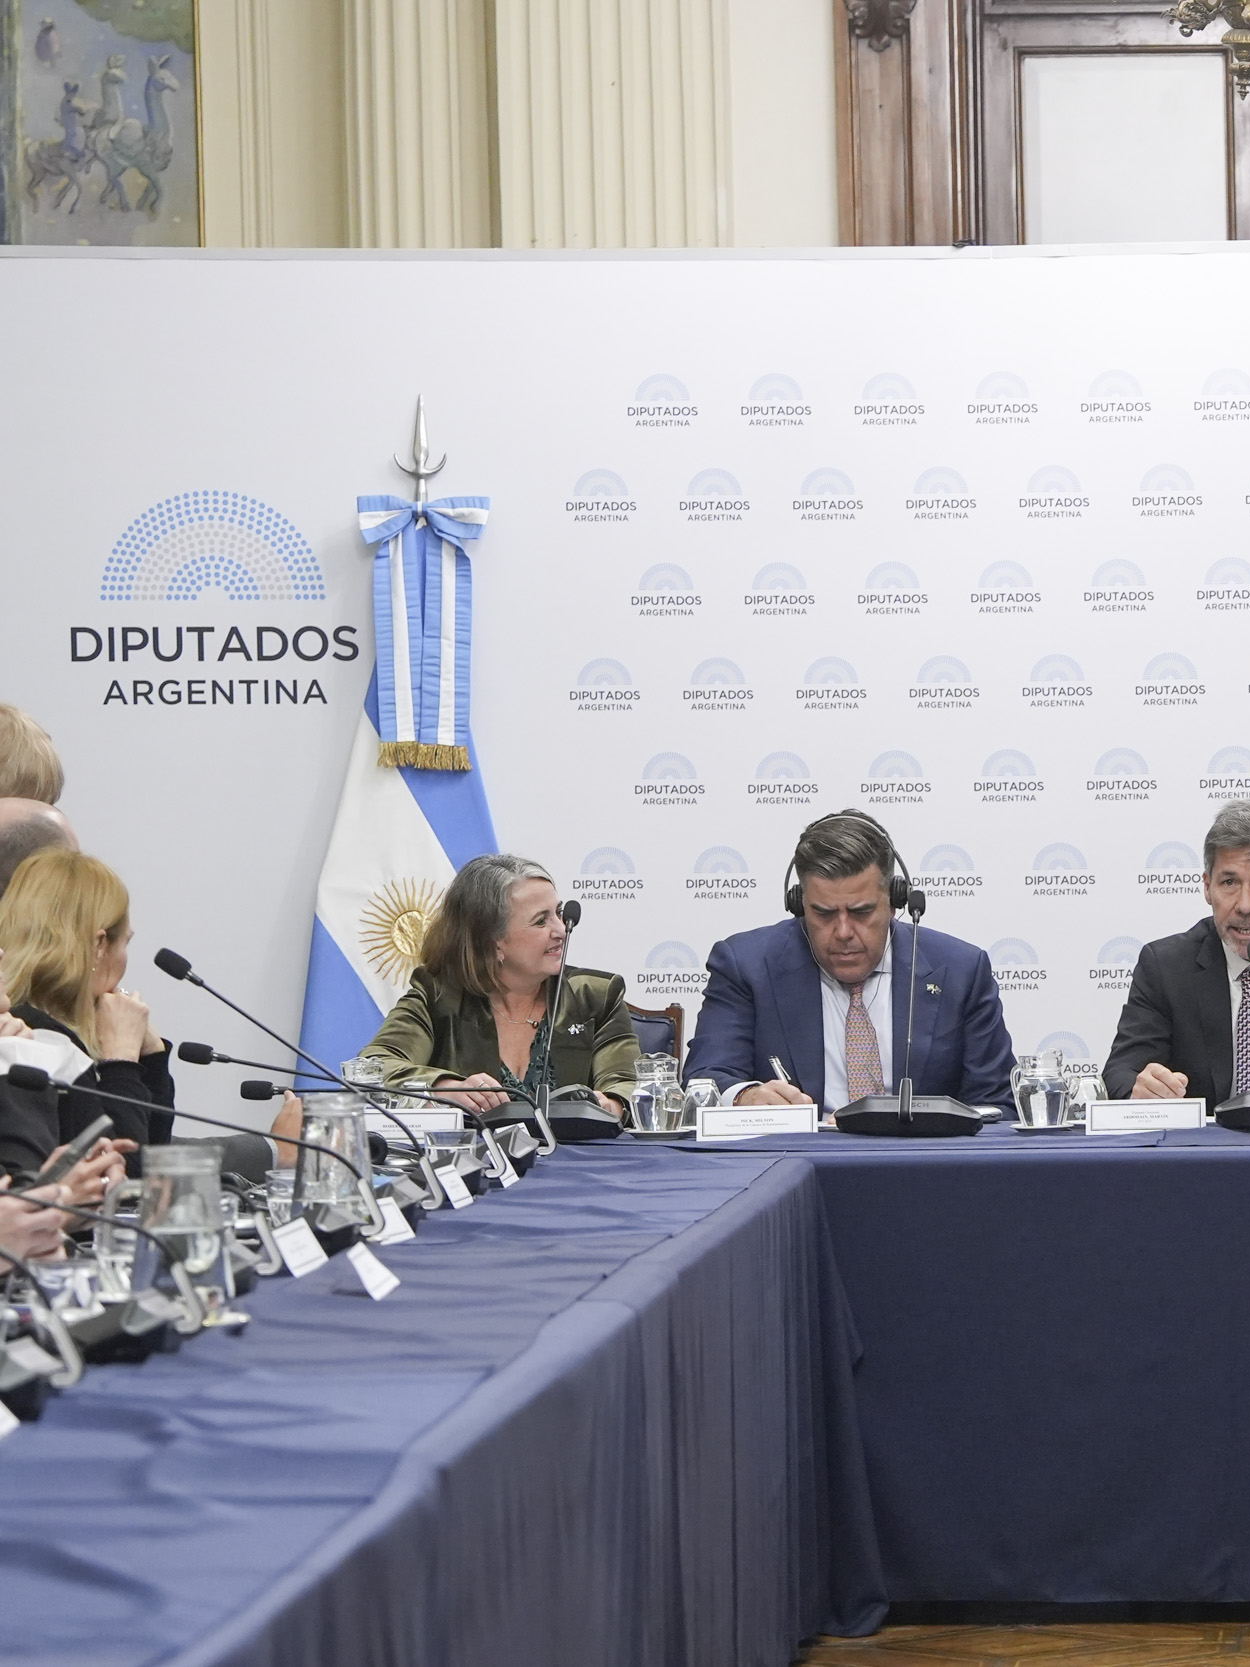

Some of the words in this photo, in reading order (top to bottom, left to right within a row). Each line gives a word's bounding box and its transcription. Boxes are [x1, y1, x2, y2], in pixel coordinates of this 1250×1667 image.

[627, 406, 699, 417] DIPUTADOS
[740, 405, 812, 416] DIPUTADOS
[854, 404, 925, 416] DIPUTADOS
[967, 403, 1039, 414] DIPUTADOS
[635, 419, 691, 427] ARGENTINA
[748, 418, 804, 427] ARGENTINA
[862, 417, 918, 426] ARGENTINA
[975, 416, 1031, 425] ARGENTINA
[565, 501, 637, 512] DIPUTADOS
[679, 500, 751, 511] DIPUTADOS
[792, 499, 864, 511] DIPUTADOS
[905, 498, 977, 510] DIPUTADOS
[1018, 497, 1090, 508] DIPUTADOS
[1132, 495, 1203, 507] DIPUTADOS
[573, 514, 629, 522] ARGENTINA
[687, 513, 743, 522] ARGENTINA
[800, 513, 856, 521] ARGENTINA
[913, 512, 969, 520] ARGENTINA
[1026, 510, 1082, 519] ARGENTINA
[1140, 508, 1195, 517] ARGENTINA
[630, 595, 703, 606] DIPUTADOS
[744, 594, 816, 606] DIPUTADOS
[857, 593, 929, 605] DIPUTADOS
[970, 592, 1042, 604] DIPUTADOS
[1083, 590, 1155, 602] DIPUTADOS
[638, 608, 695, 617] ARGENTINA
[752, 607, 808, 616] ARGENTINA
[865, 606, 921, 615] ARGENTINA
[978, 605, 1034, 614] ARGENTINA
[1091, 604, 1147, 612] ARGENTINA
[70, 625, 359, 663] DIPUTADOS
[103, 678, 327, 705] ARGENTINA
[569, 690, 641, 701] DIPUTADOS
[682, 689, 754, 700] DIPUTADOS
[795, 688, 867, 700] DIPUTADOS
[909, 687, 980, 699] DIPUTADOS
[1021, 686, 1093, 697] DIPUTADOS
[1134, 684, 1206, 696] DIPUTADOS
[690, 702, 746, 711] ARGENTINA
[804, 701, 860, 710] ARGENTINA
[917, 700, 973, 709] ARGENTINA
[1029, 699, 1085, 708] ARGENTINA
[1142, 697, 1198, 706] ARGENTINA
[577, 703, 633, 712] ARGENTINA
[634, 784, 706, 795] DIPUTADOS
[747, 783, 819, 795] DIPUTADOS
[860, 782, 932, 794] DIPUTADOS
[973, 781, 1045, 792] DIPUTADOS
[1086, 779, 1158, 791] DIPUTADOS
[642, 797, 698, 806] ARGENTINA
[755, 796, 811, 805] ARGENTINA
[868, 795, 924, 804] ARGENTINA
[981, 794, 1037, 803] ARGENTINA
[1094, 792, 1150, 801] ARGENTINA
[572, 879, 644, 890] DIPUTADOS
[685, 878, 757, 889] DIPUTADOS
[911, 876, 983, 887] DIPUTADOS
[1024, 874, 1096, 886] DIPUTADOS
[580, 892, 636, 901] ARGENTINA
[693, 891, 749, 900] ARGENTINA
[1032, 888, 1088, 896] ARGENTINA
[1145, 887, 1201, 895] ARGENTINA
[637, 973, 708, 984] DIPUTADOS
[645, 986, 700, 994] ARGENTINA
